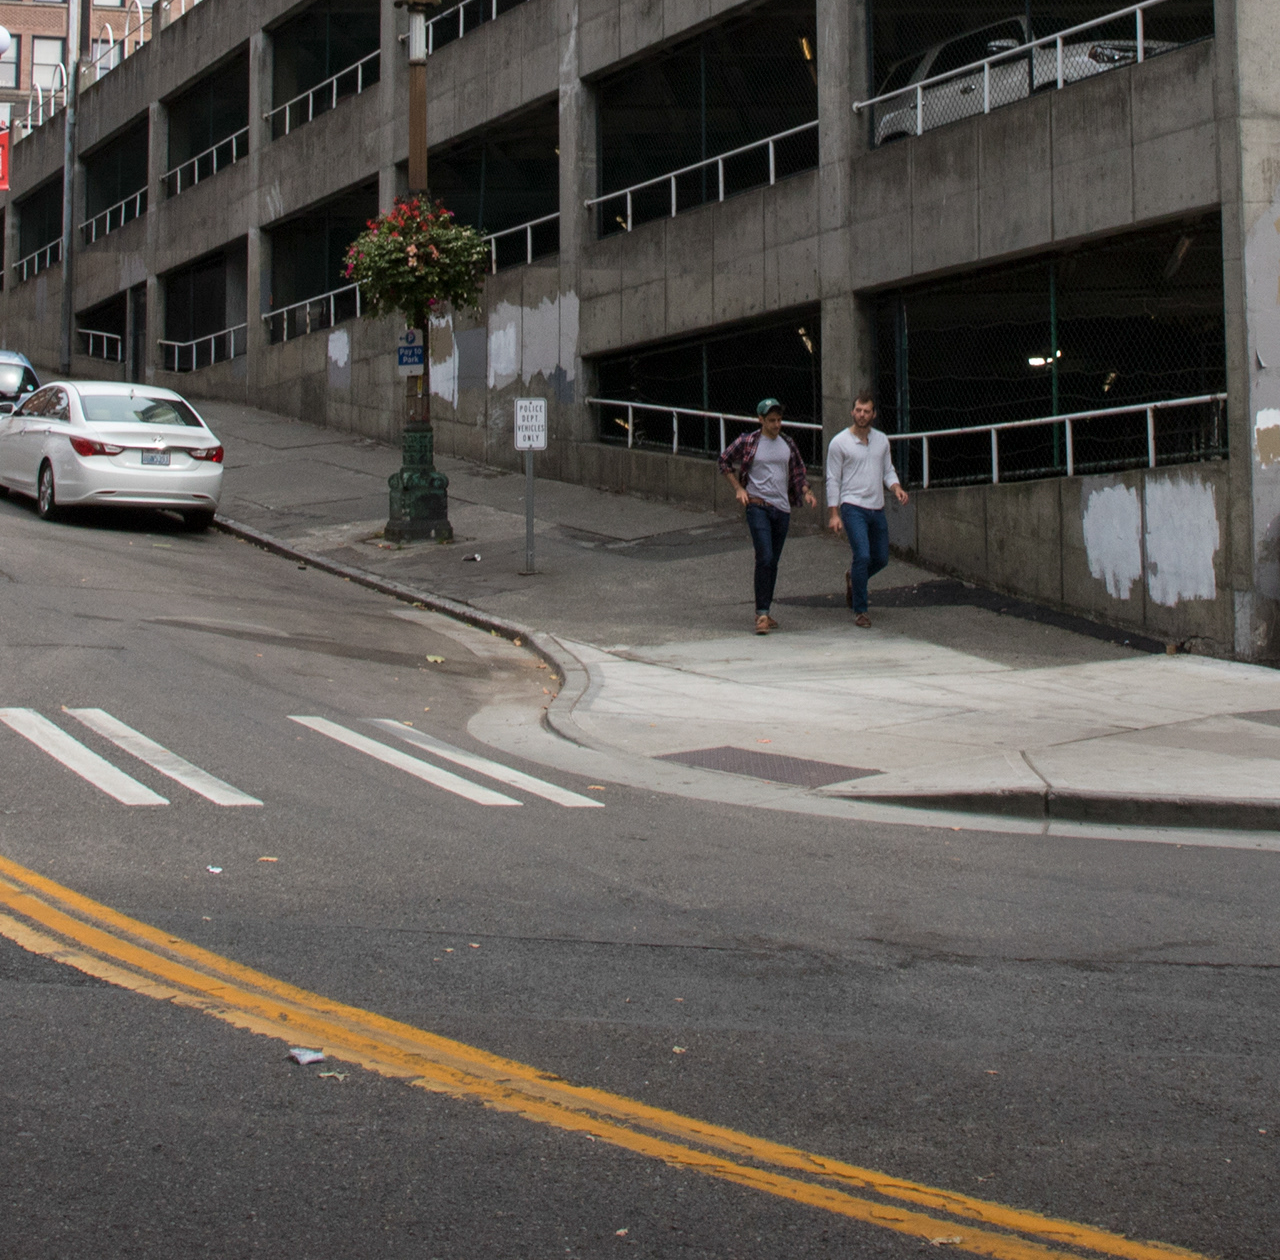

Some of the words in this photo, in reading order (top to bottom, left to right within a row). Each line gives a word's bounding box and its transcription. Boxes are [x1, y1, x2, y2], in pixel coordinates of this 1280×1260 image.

[400, 348, 413, 356] Pay
[402, 356, 419, 364] Park
[519, 404, 543, 413] POLICE
[518, 424, 545, 433] VEHICLES
[522, 434, 540, 442] ONLY
